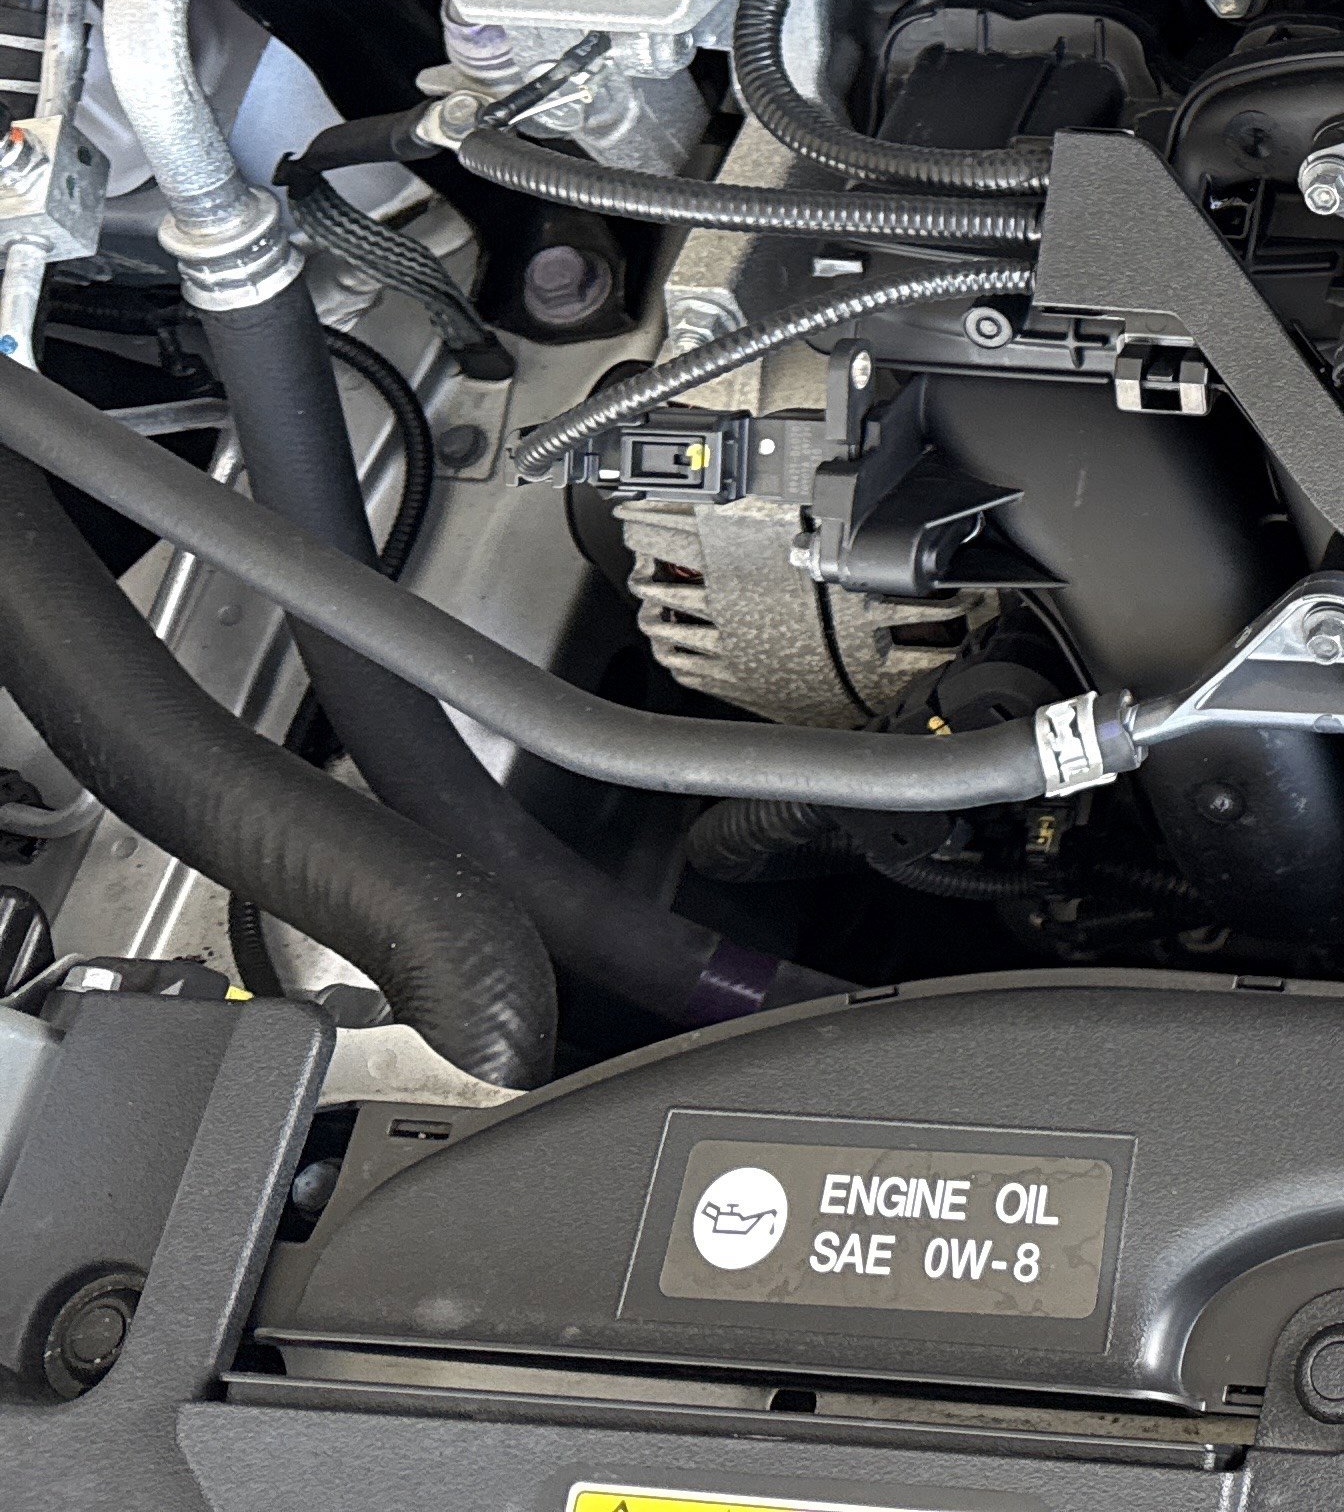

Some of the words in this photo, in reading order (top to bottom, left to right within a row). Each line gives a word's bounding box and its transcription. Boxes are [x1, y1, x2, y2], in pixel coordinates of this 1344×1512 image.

[820, 1173, 970, 1221] ENGINE
[995, 1182, 1059, 1226] OIL
[809, 1231, 896, 1276] SAE
[923, 1237, 1039, 1283] 0W-8
